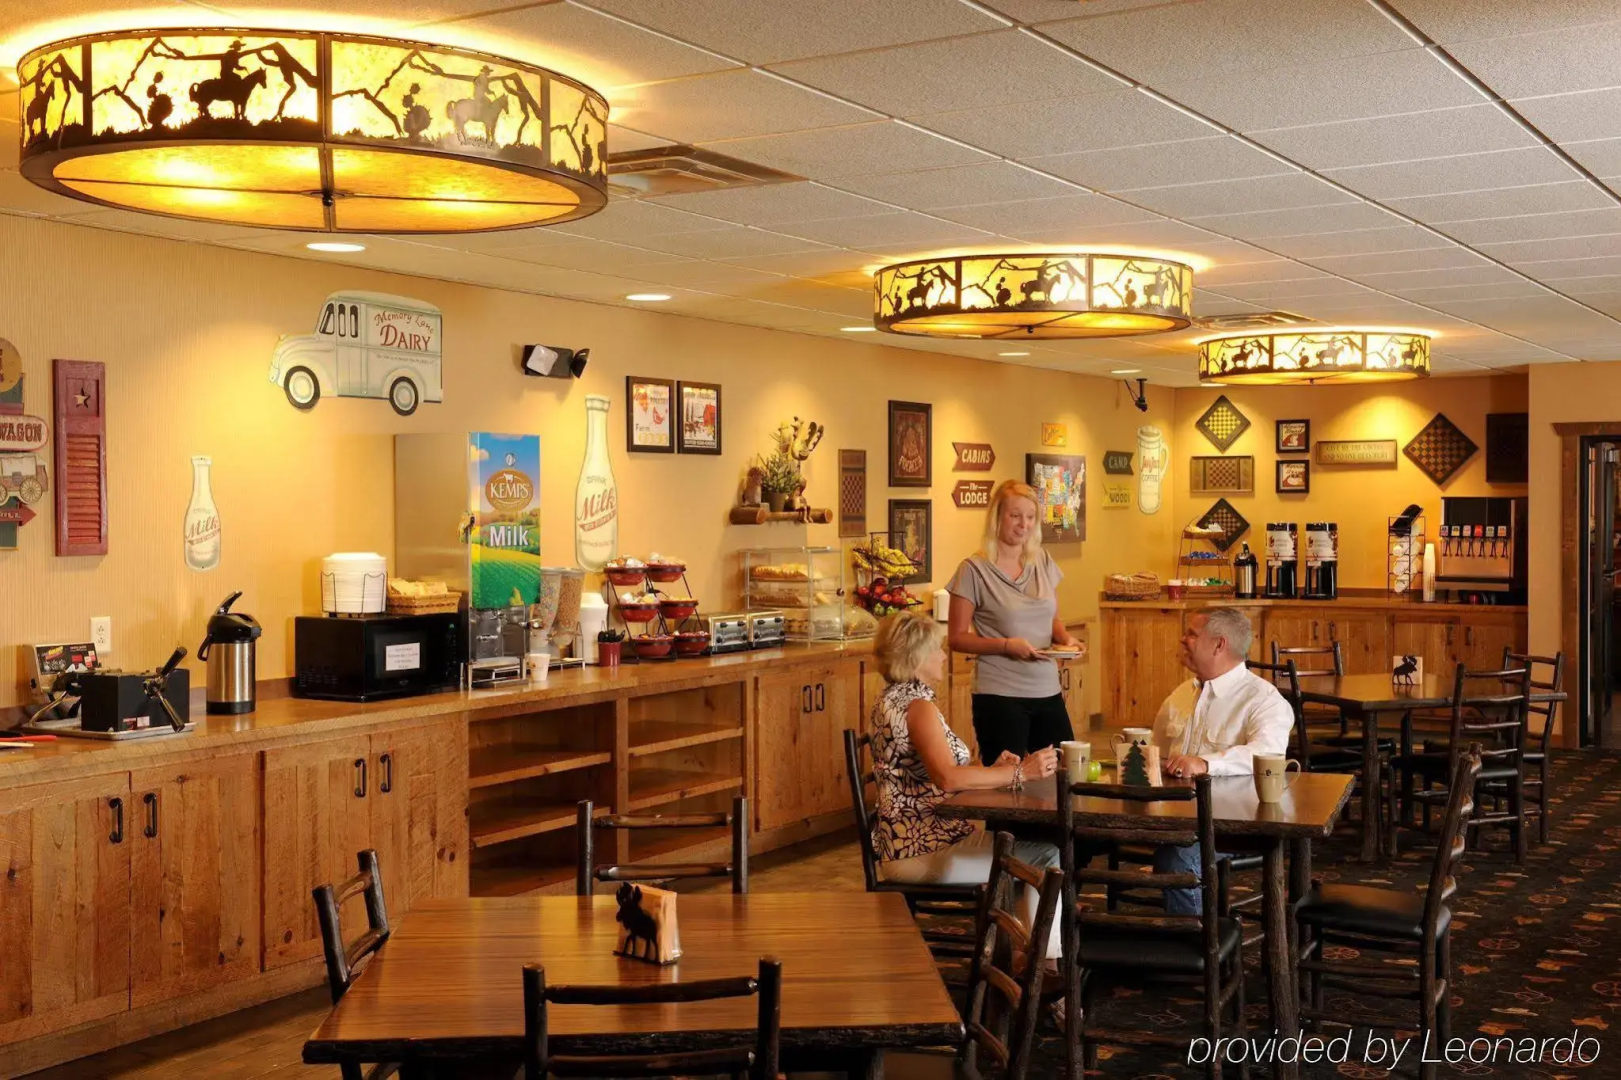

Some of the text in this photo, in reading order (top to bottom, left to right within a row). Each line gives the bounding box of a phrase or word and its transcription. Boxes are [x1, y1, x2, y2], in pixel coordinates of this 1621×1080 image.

[374, 311, 434, 334] Memory Lane
[380, 324, 431, 351] DAIRY
[962, 449, 991, 464] CABINS
[1109, 456, 1128, 469] CAMP
[490, 482, 529, 499] KEMPS
[960, 492, 987, 504] LODGE
[576, 487, 616, 521] Milk
[185, 515, 219, 539] Milk
[489, 524, 530, 547] Milk
